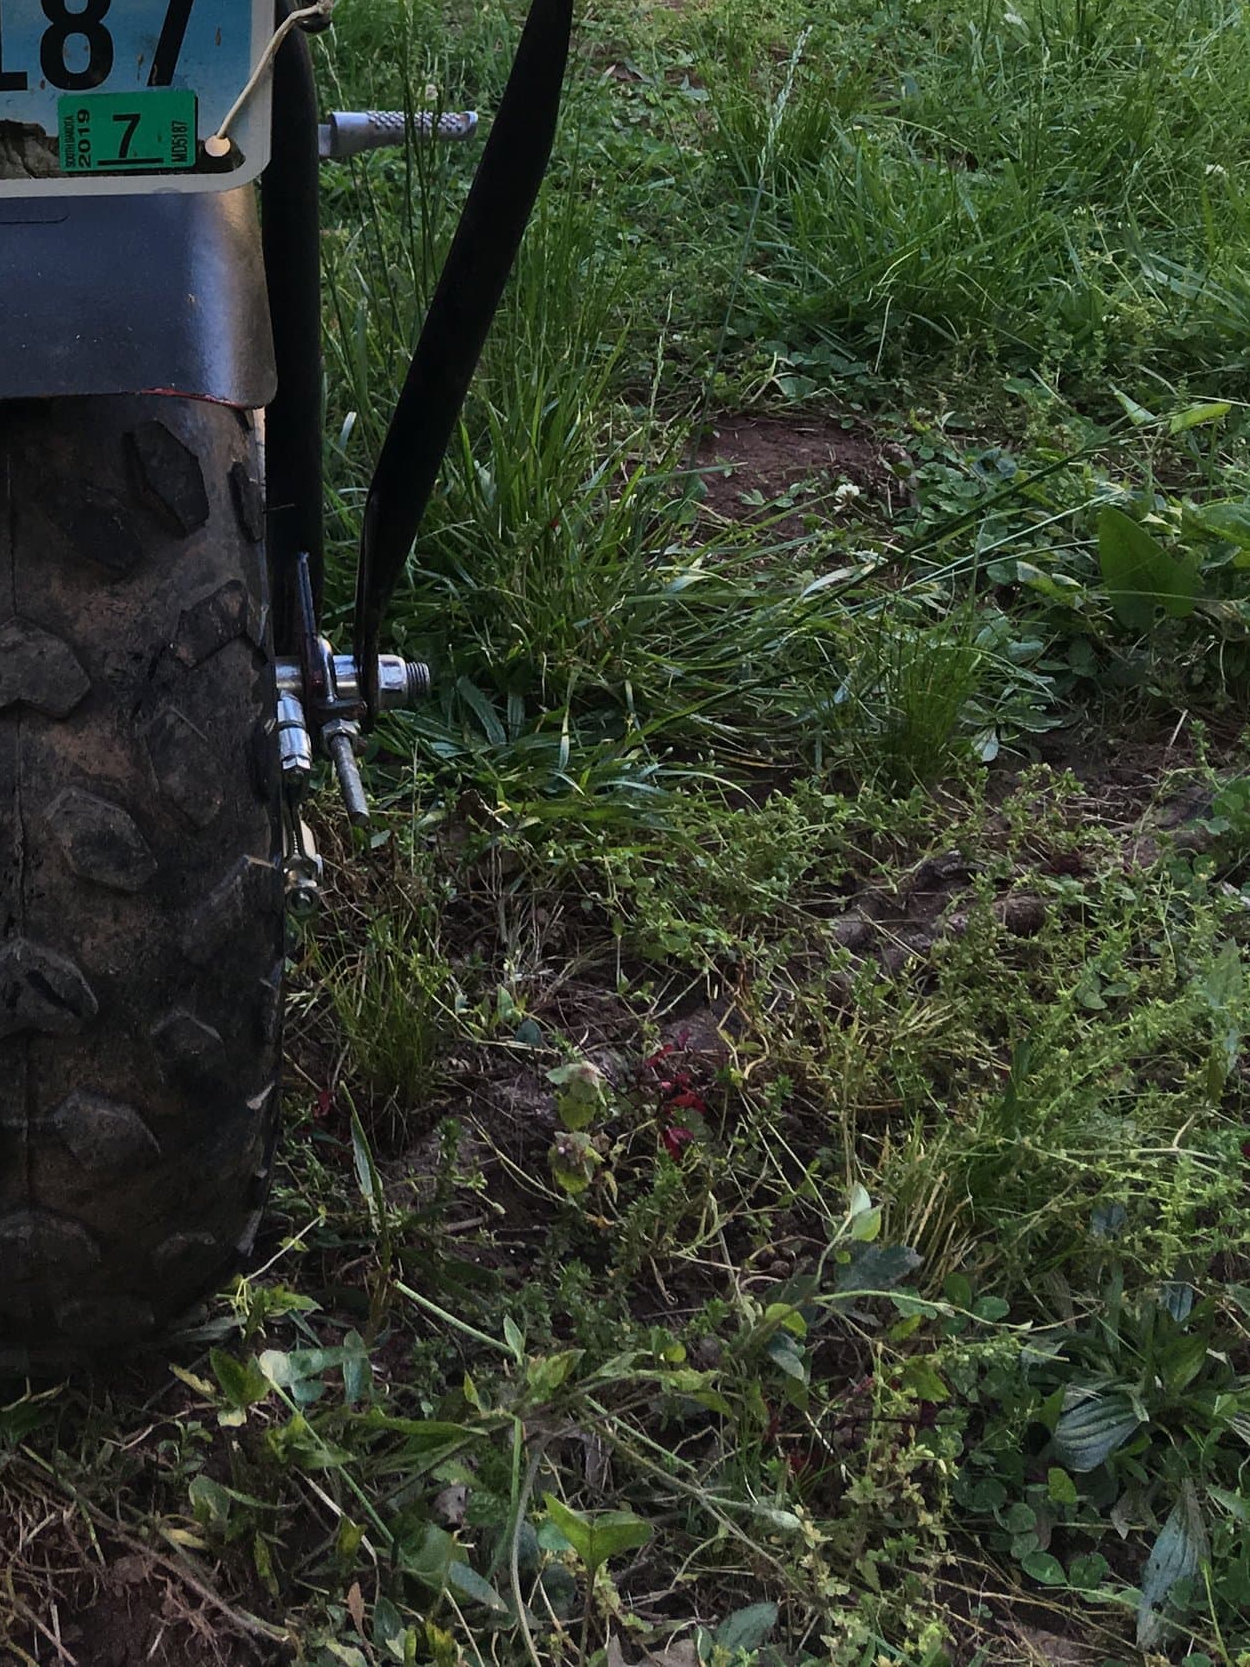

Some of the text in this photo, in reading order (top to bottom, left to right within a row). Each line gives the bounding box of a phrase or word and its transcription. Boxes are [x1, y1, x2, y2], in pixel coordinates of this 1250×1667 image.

[77, 109, 91, 168] 2019
[112, 113, 141, 159] 7
[171, 120, 188, 162] MD5187
